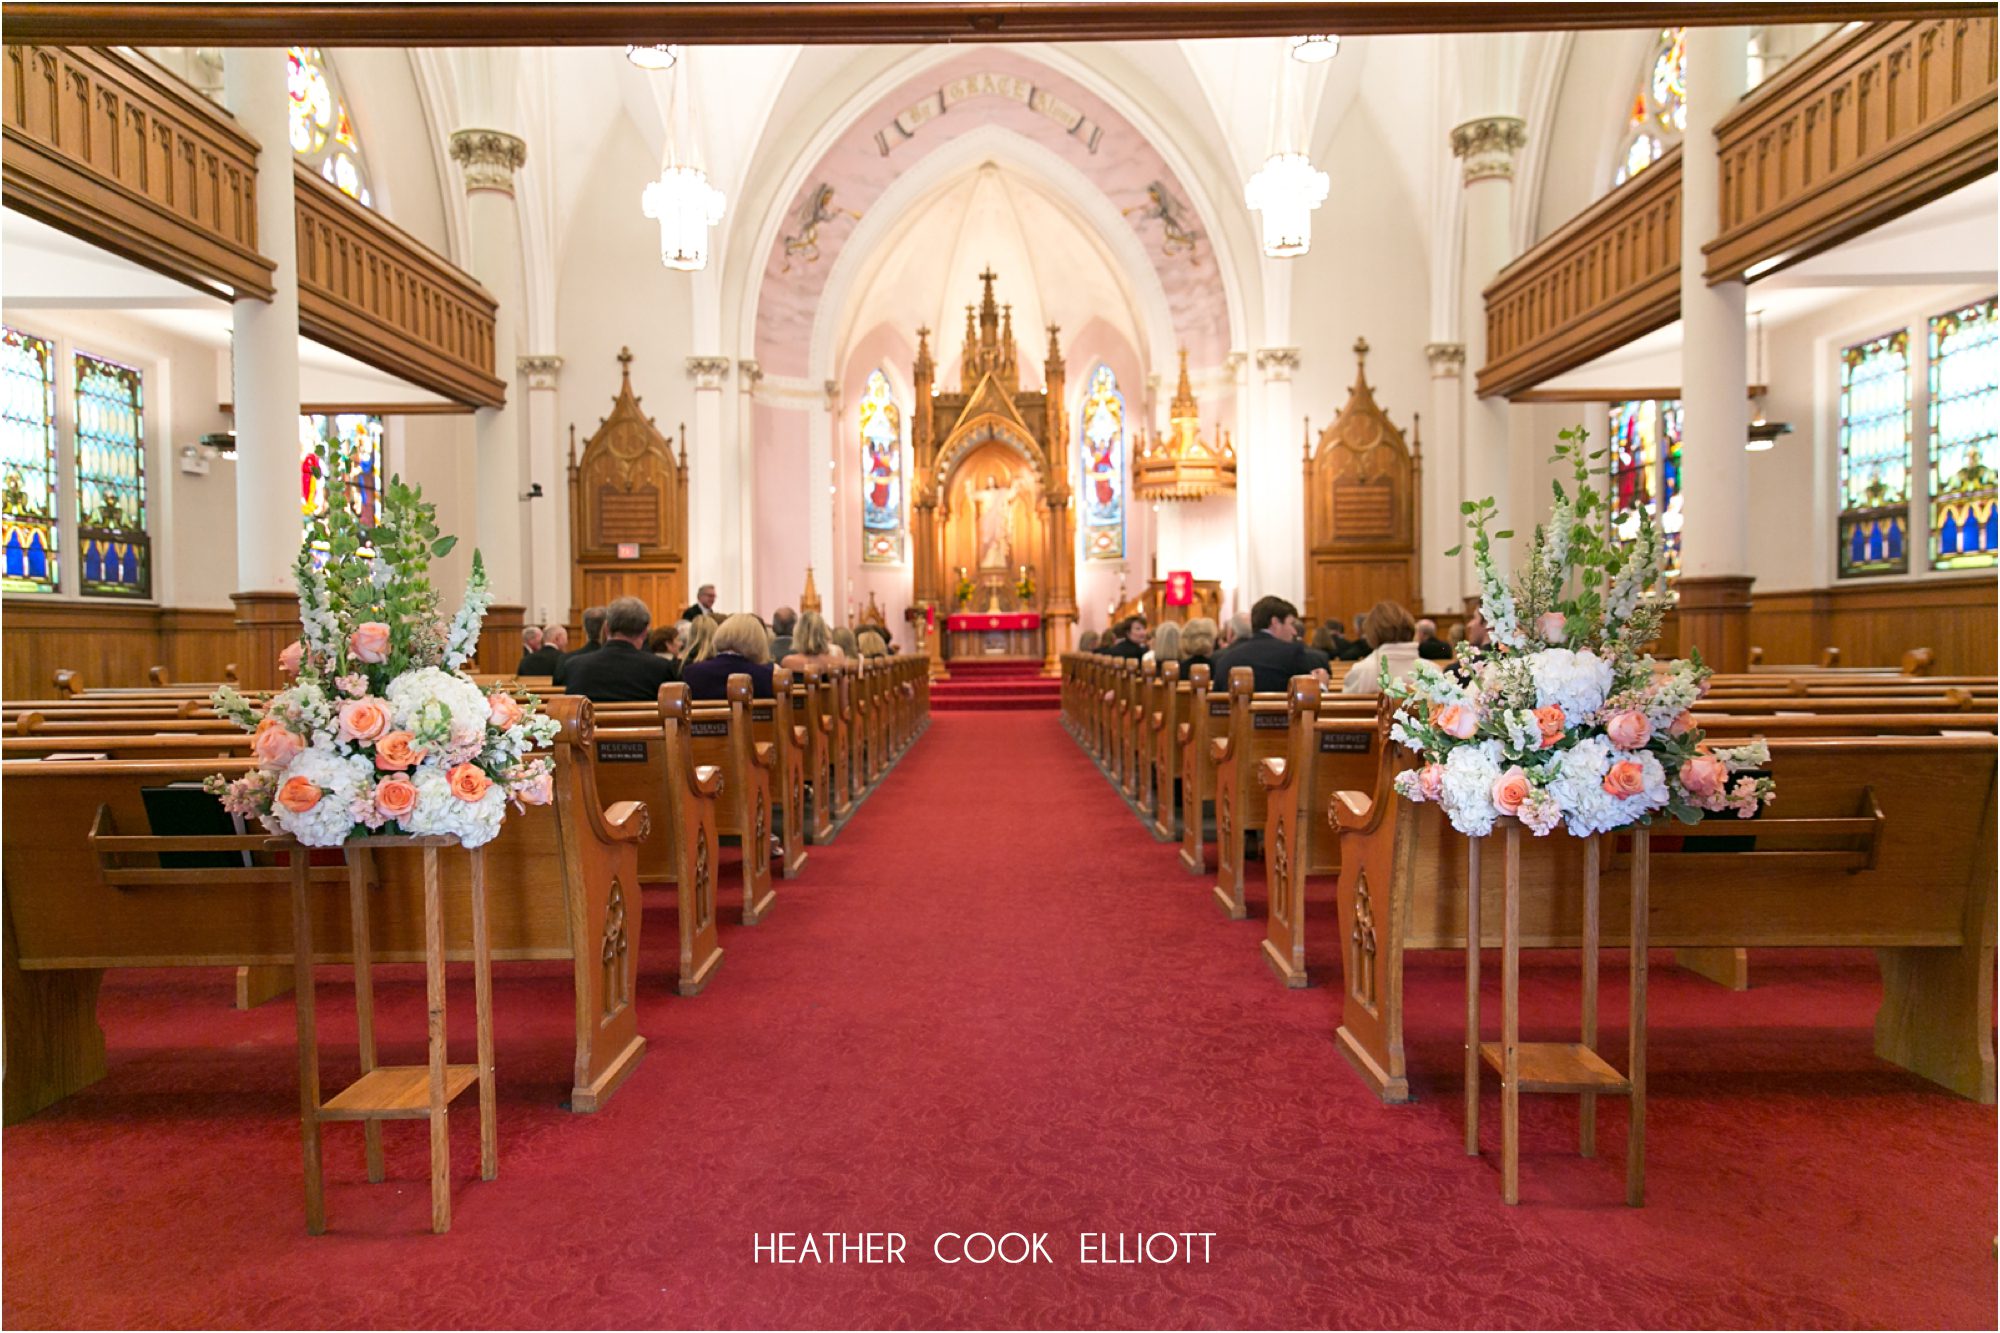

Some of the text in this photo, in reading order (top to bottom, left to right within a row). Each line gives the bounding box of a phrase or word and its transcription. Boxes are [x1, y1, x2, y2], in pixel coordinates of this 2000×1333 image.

[949, 73, 1025, 99] GRACE
[1324, 734, 1367, 742] RESERVED
[600, 743, 643, 752] RESERVED
